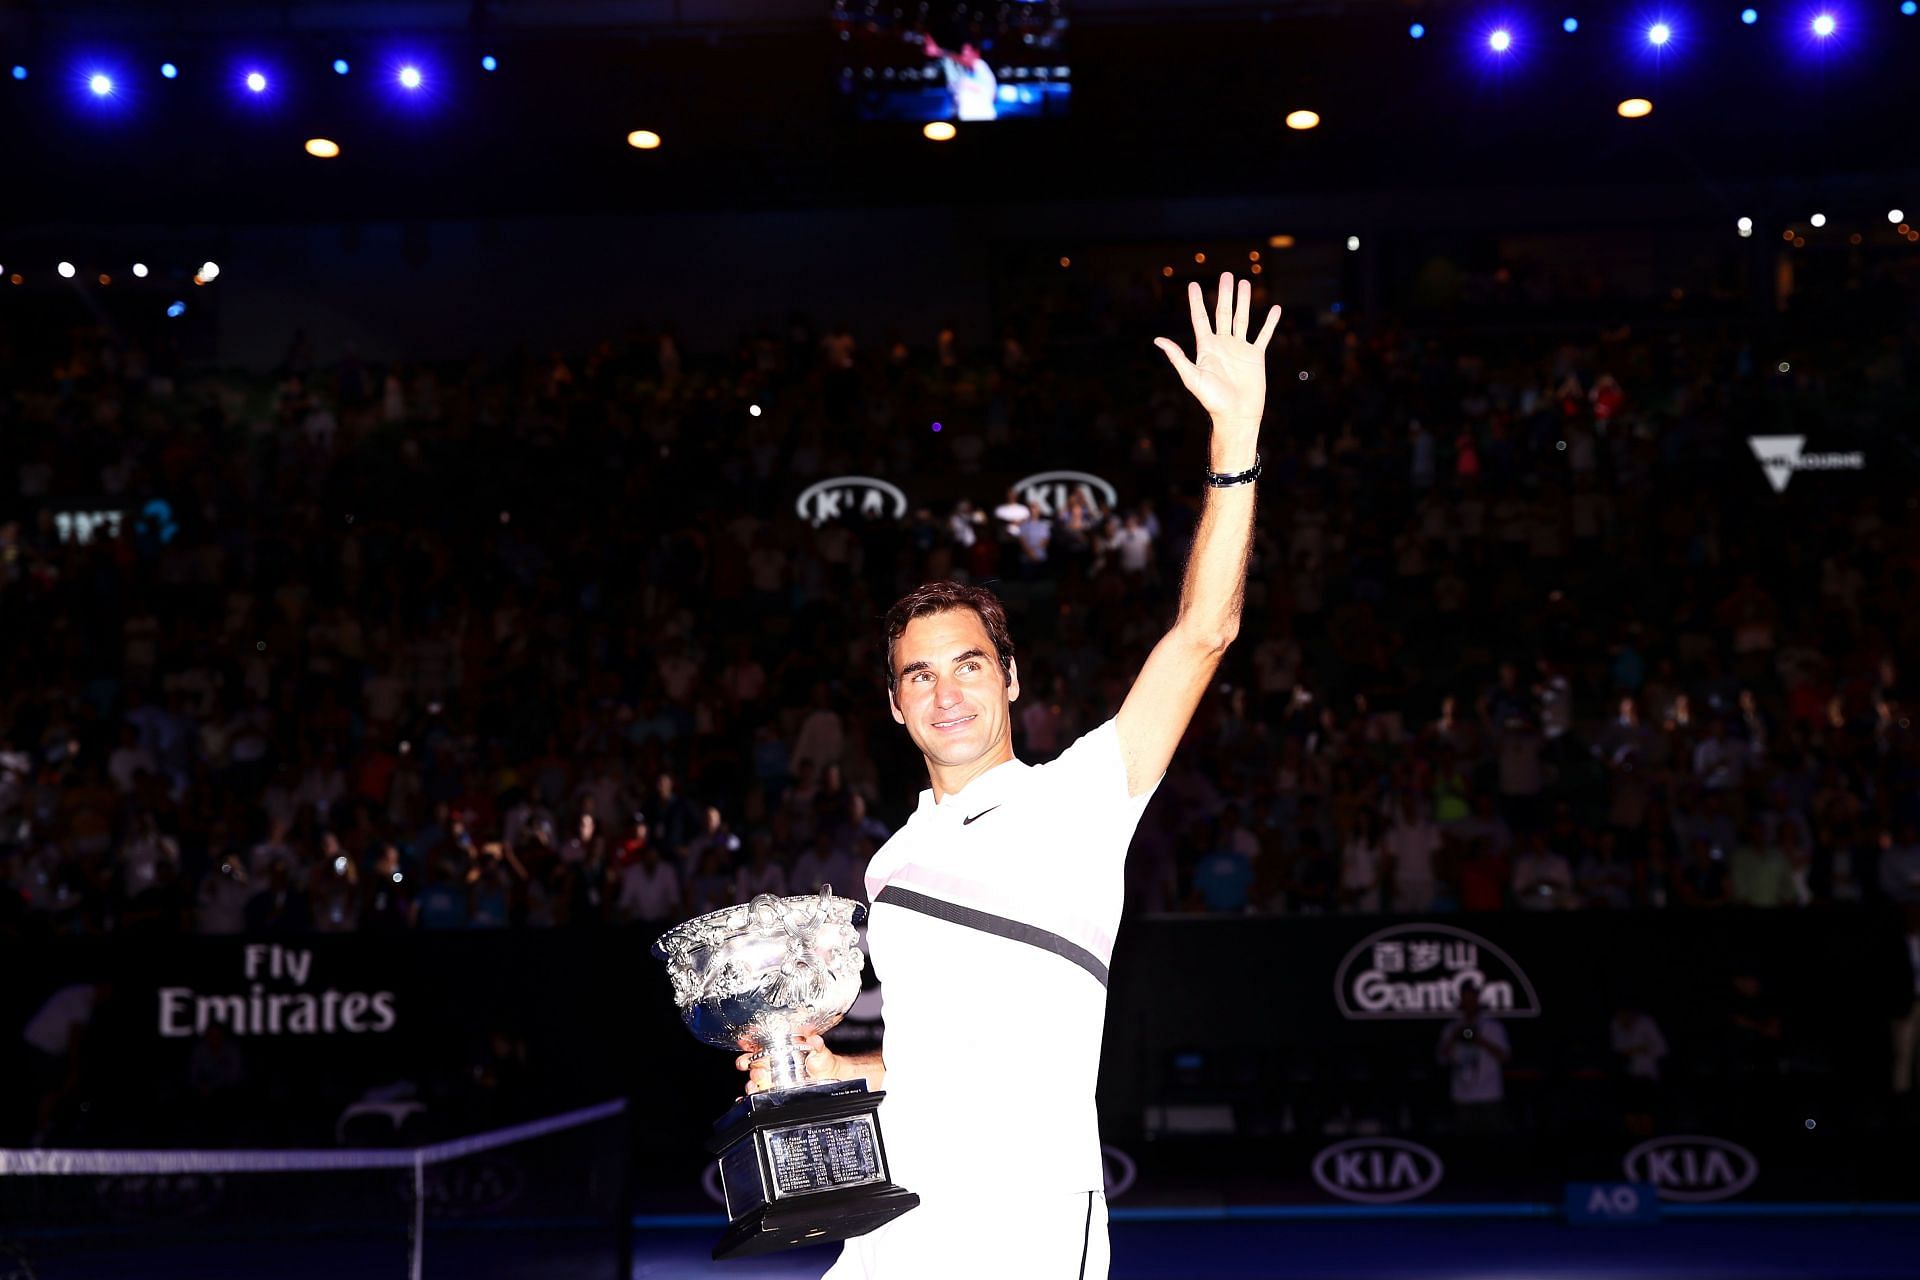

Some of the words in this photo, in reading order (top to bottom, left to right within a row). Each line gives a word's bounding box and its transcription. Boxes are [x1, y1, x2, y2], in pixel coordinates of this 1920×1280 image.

[243, 943, 313, 987] Fly
[157, 982, 397, 1038] Emirates
[1334, 1149, 1424, 1189] KIA
[1646, 1148, 1738, 1187] KIA
[1586, 1185, 1640, 1215] AO
